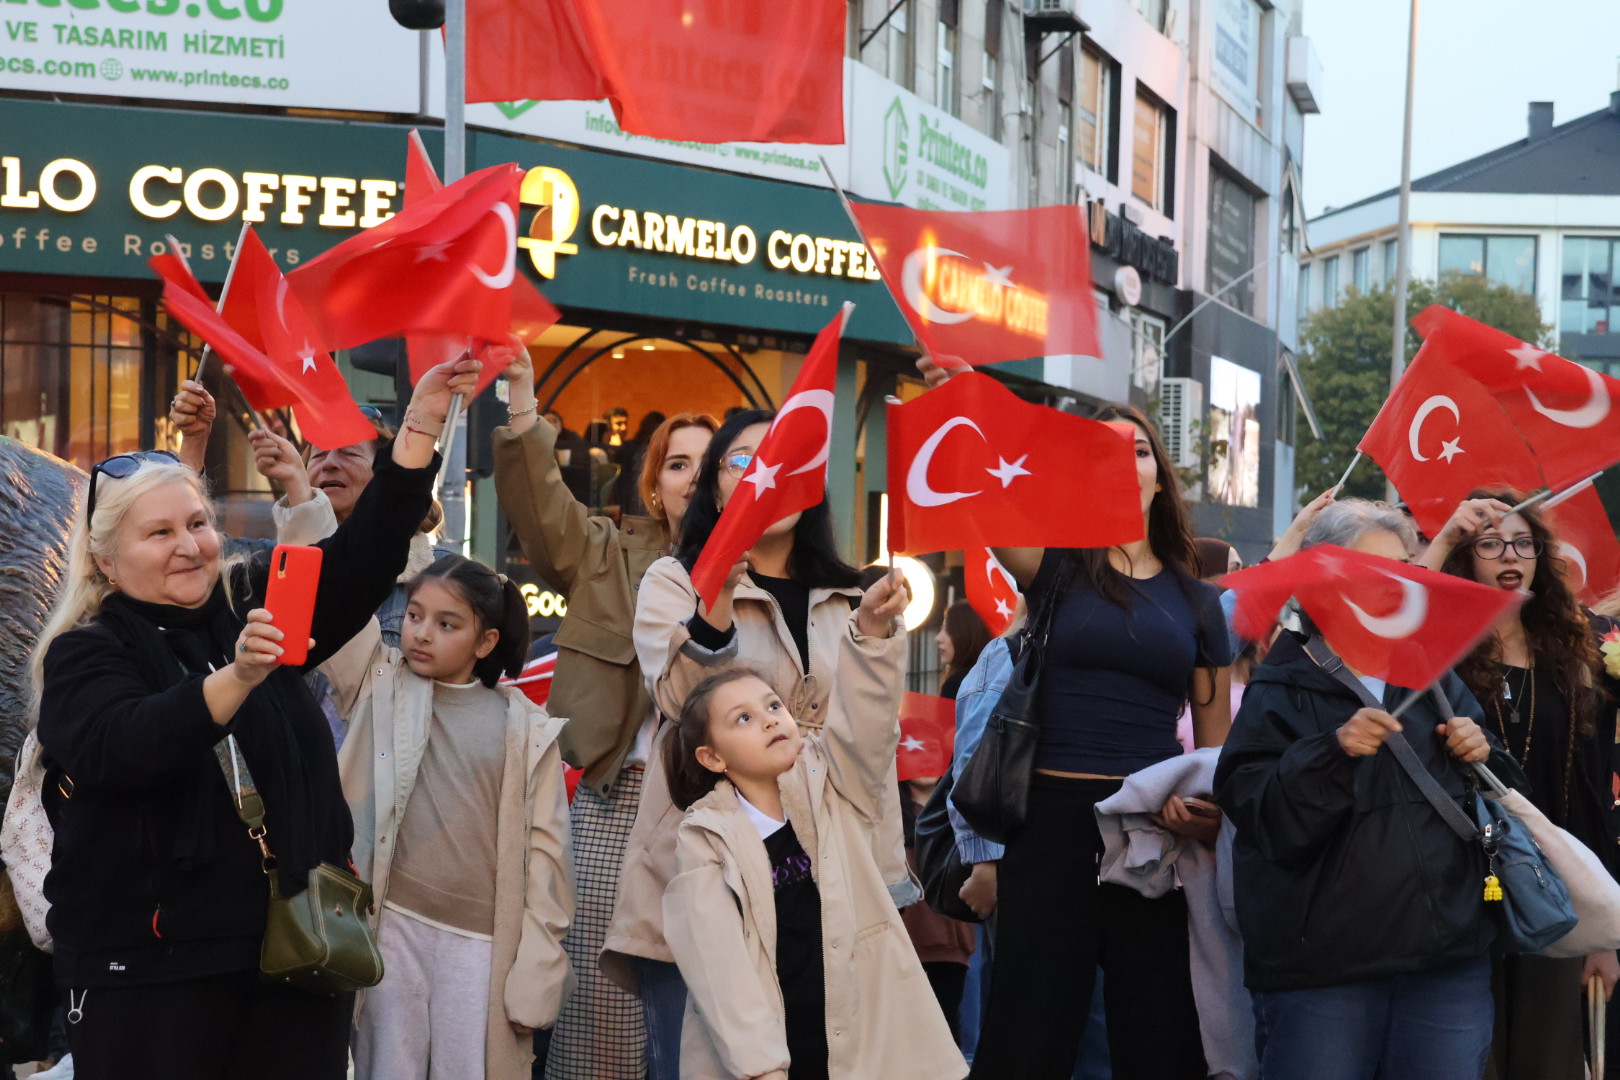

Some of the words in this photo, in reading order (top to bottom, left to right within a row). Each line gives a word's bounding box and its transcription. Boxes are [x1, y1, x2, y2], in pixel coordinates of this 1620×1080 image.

[6, 20, 38, 42] VE
[53, 24, 168, 51] TASARIM
[184, 29, 285, 59] HİZMETİ
[130, 67, 290, 90] www.printecs.co
[129, 164, 398, 228] COFFEE
[0, 227, 98, 253] ffee
[124, 234, 301, 265] Roastrs
[592, 204, 757, 265] CARMELO
[628, 266, 678, 288] Fresh
[686, 273, 747, 297] Coffee
[754, 283, 829, 307] Roasters
